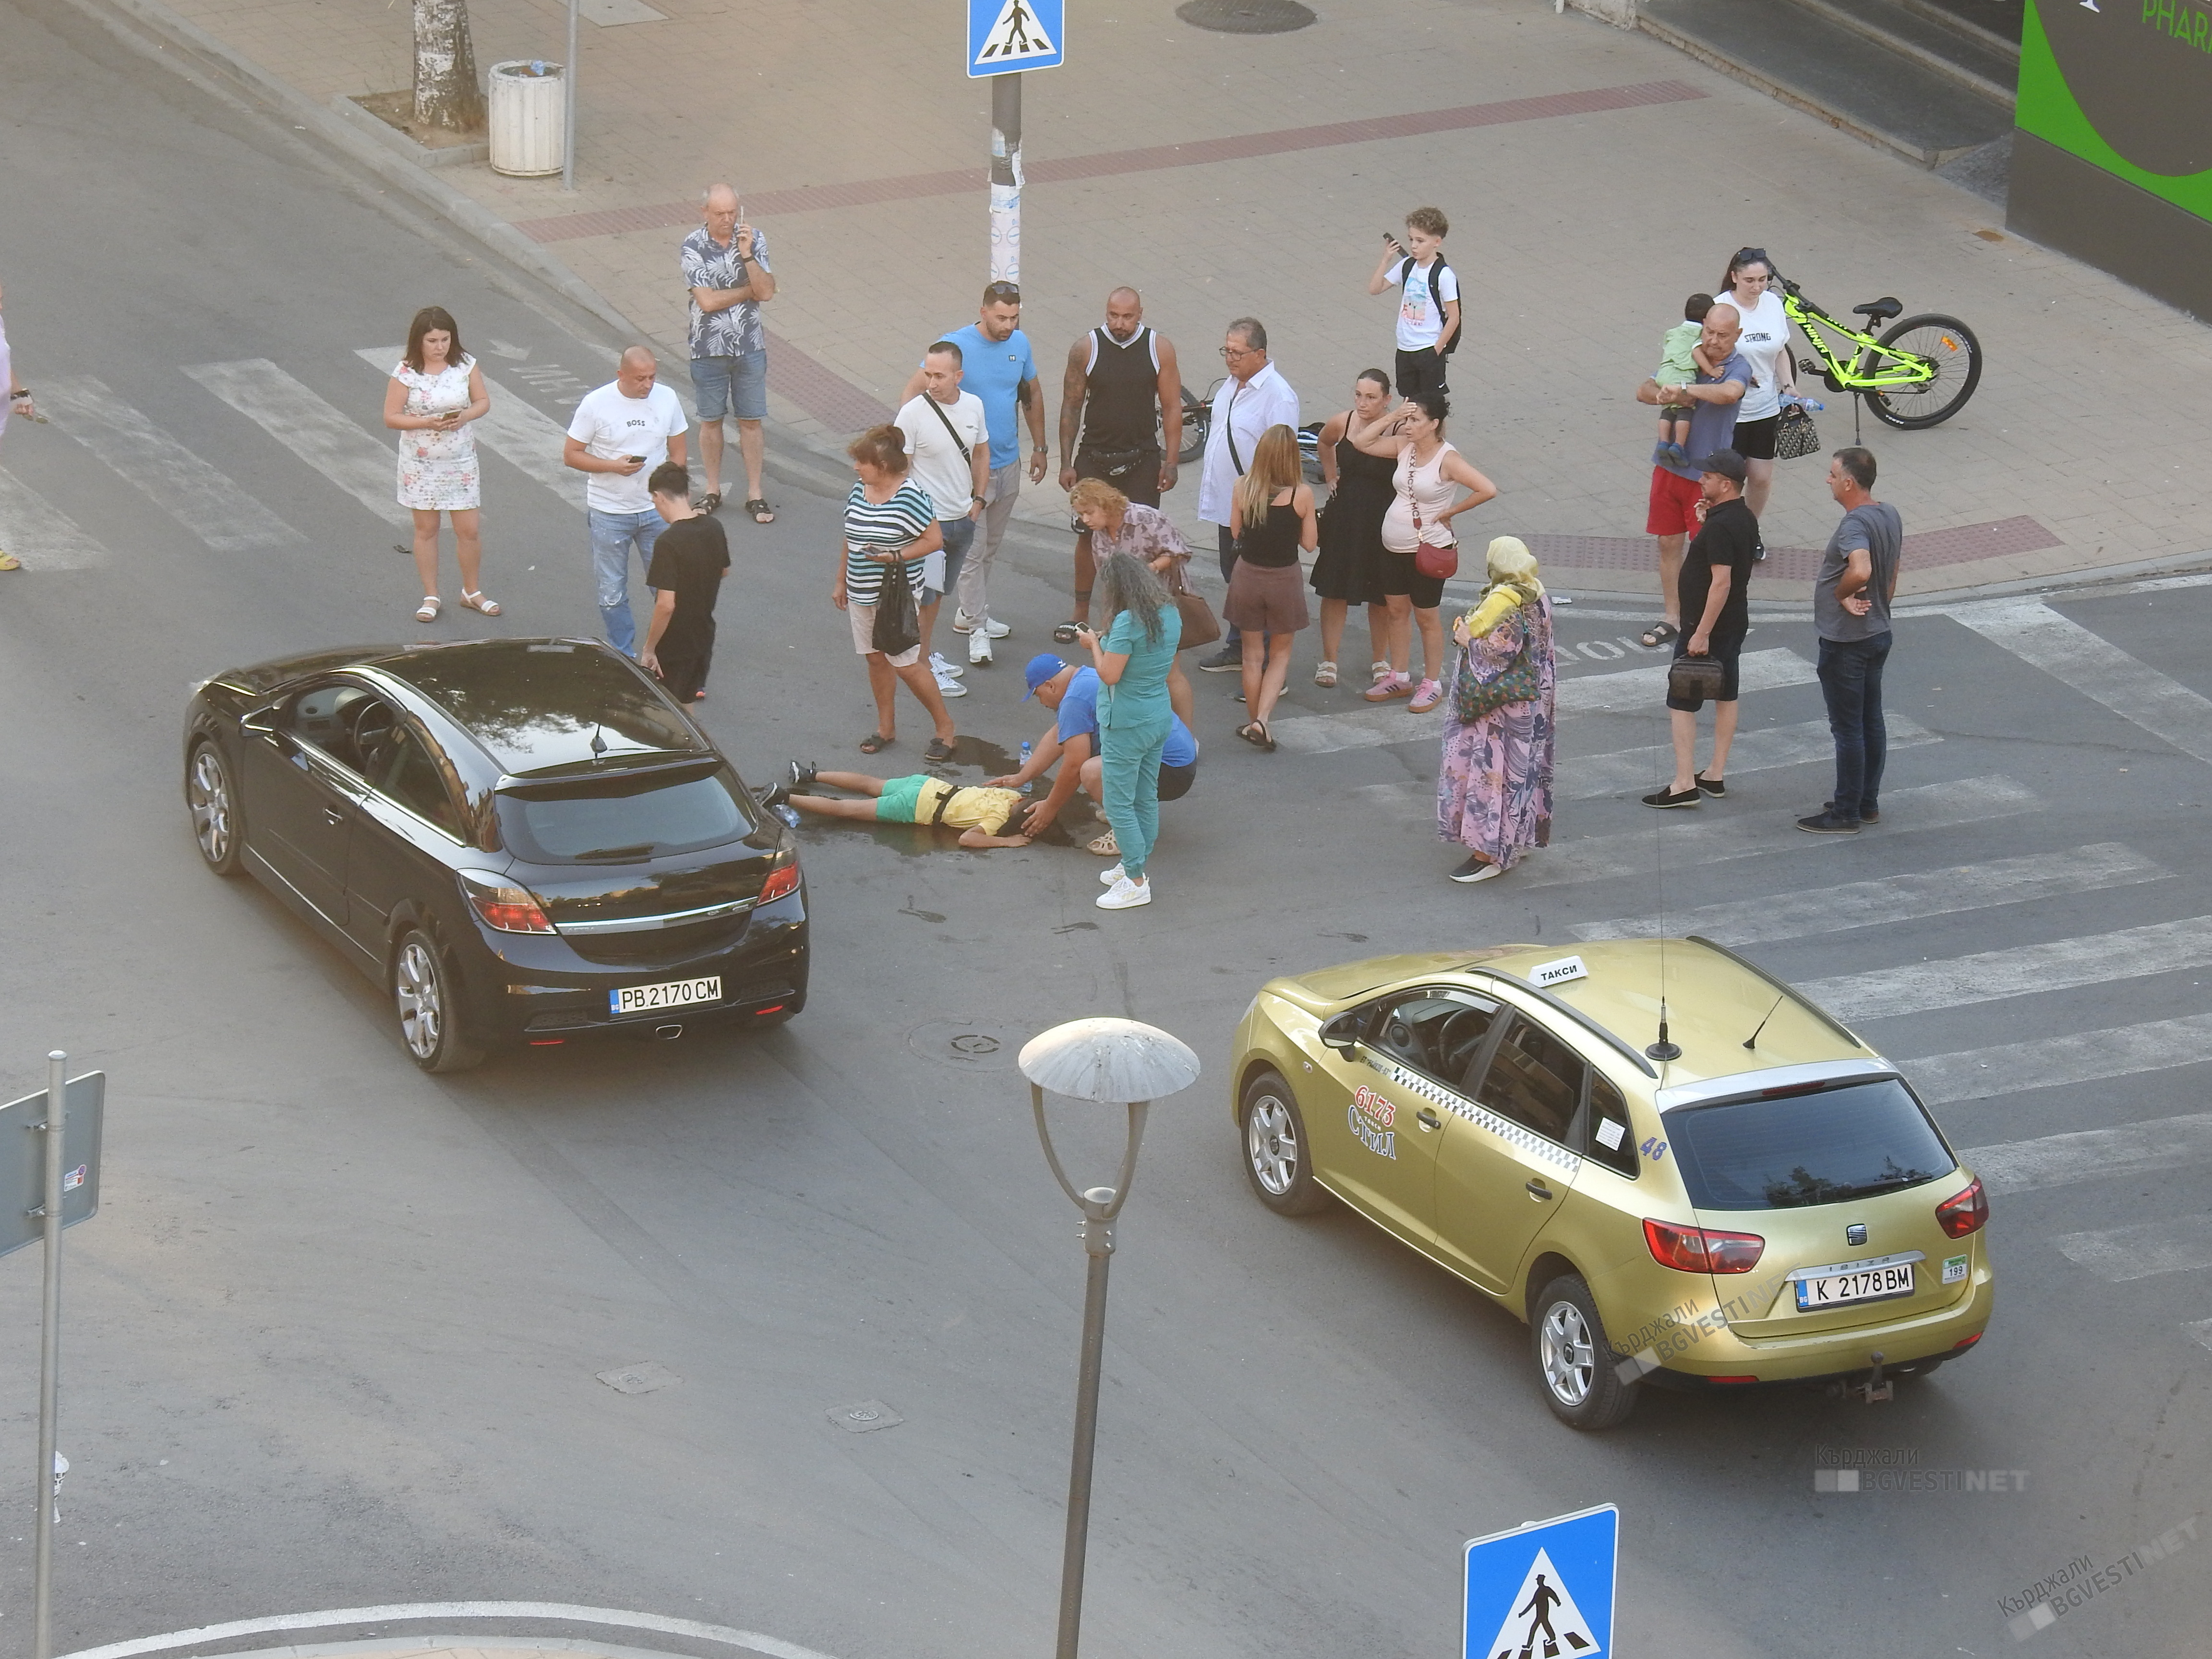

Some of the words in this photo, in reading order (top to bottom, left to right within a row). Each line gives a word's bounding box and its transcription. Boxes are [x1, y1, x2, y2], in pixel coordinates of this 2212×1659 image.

[2142, 0, 2212, 53] PHAR
[1744, 332, 1771, 343] STRONG
[1803, 324, 1829, 353] NINJA
[1540, 964, 1577, 981] ТАКСИ
[649, 984, 692, 1006] 2170
[1355, 1085, 1396, 1127] 6173
[1348, 1105, 1396, 1160] СТИЛ
[1640, 1137, 1667, 1161] 48
[1949, 1266, 1963, 1276] 199
